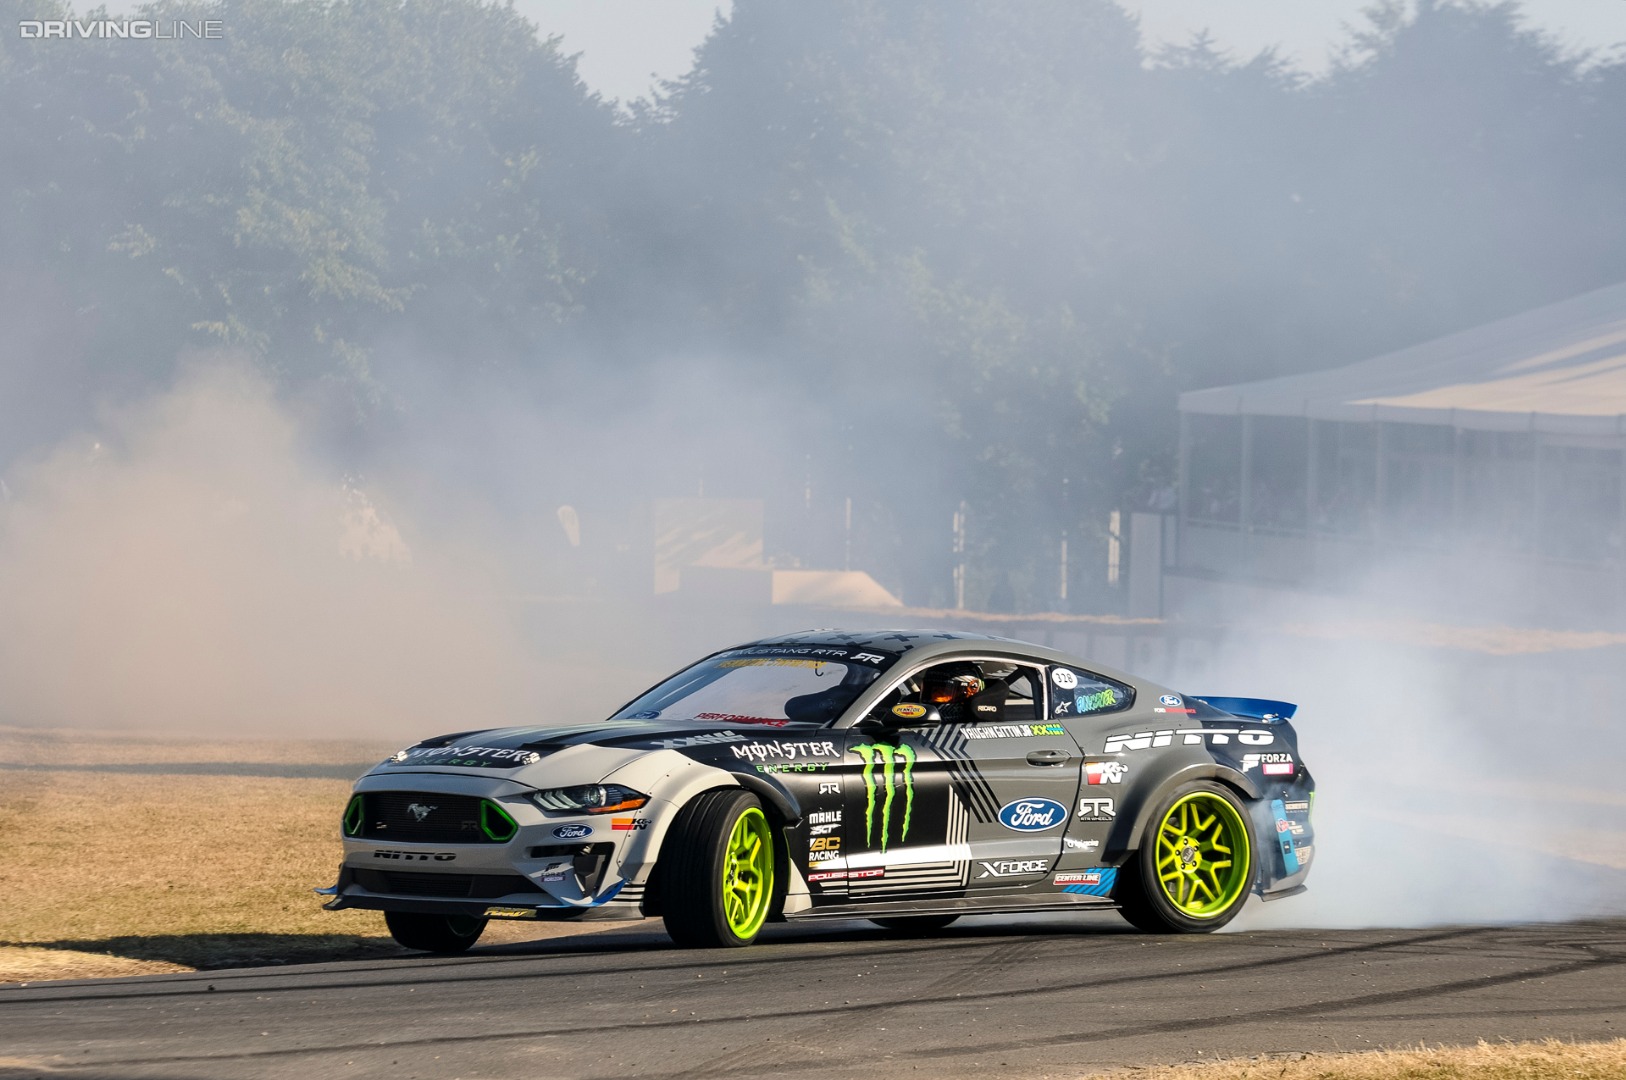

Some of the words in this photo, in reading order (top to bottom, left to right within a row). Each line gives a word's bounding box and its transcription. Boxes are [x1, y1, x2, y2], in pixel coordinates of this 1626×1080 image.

[811, 648, 848, 657] RTR
[1055, 673, 1074, 684] 328
[977, 705, 998, 713] RECARO
[694, 712, 790, 728] PERFORMANCE
[960, 727, 998, 740] VAUGHN
[1103, 729, 1275, 754] NITTO
[409, 746, 526, 761] MONSTER
[730, 740, 840, 762] MONSTER
[1261, 753, 1294, 763] FORZA
[756, 762, 828, 773] ENERGY
[808, 811, 842, 825] MAHLE
[1010, 802, 1055, 826] Ford
[560, 825, 586, 838] Ford
[810, 836, 841, 851] BC
[373, 849, 457, 862] NITTO
[808, 850, 840, 862] RACING
[1055, 873, 1082, 882] CENTER
[1081, 873, 1100, 882] LINE
